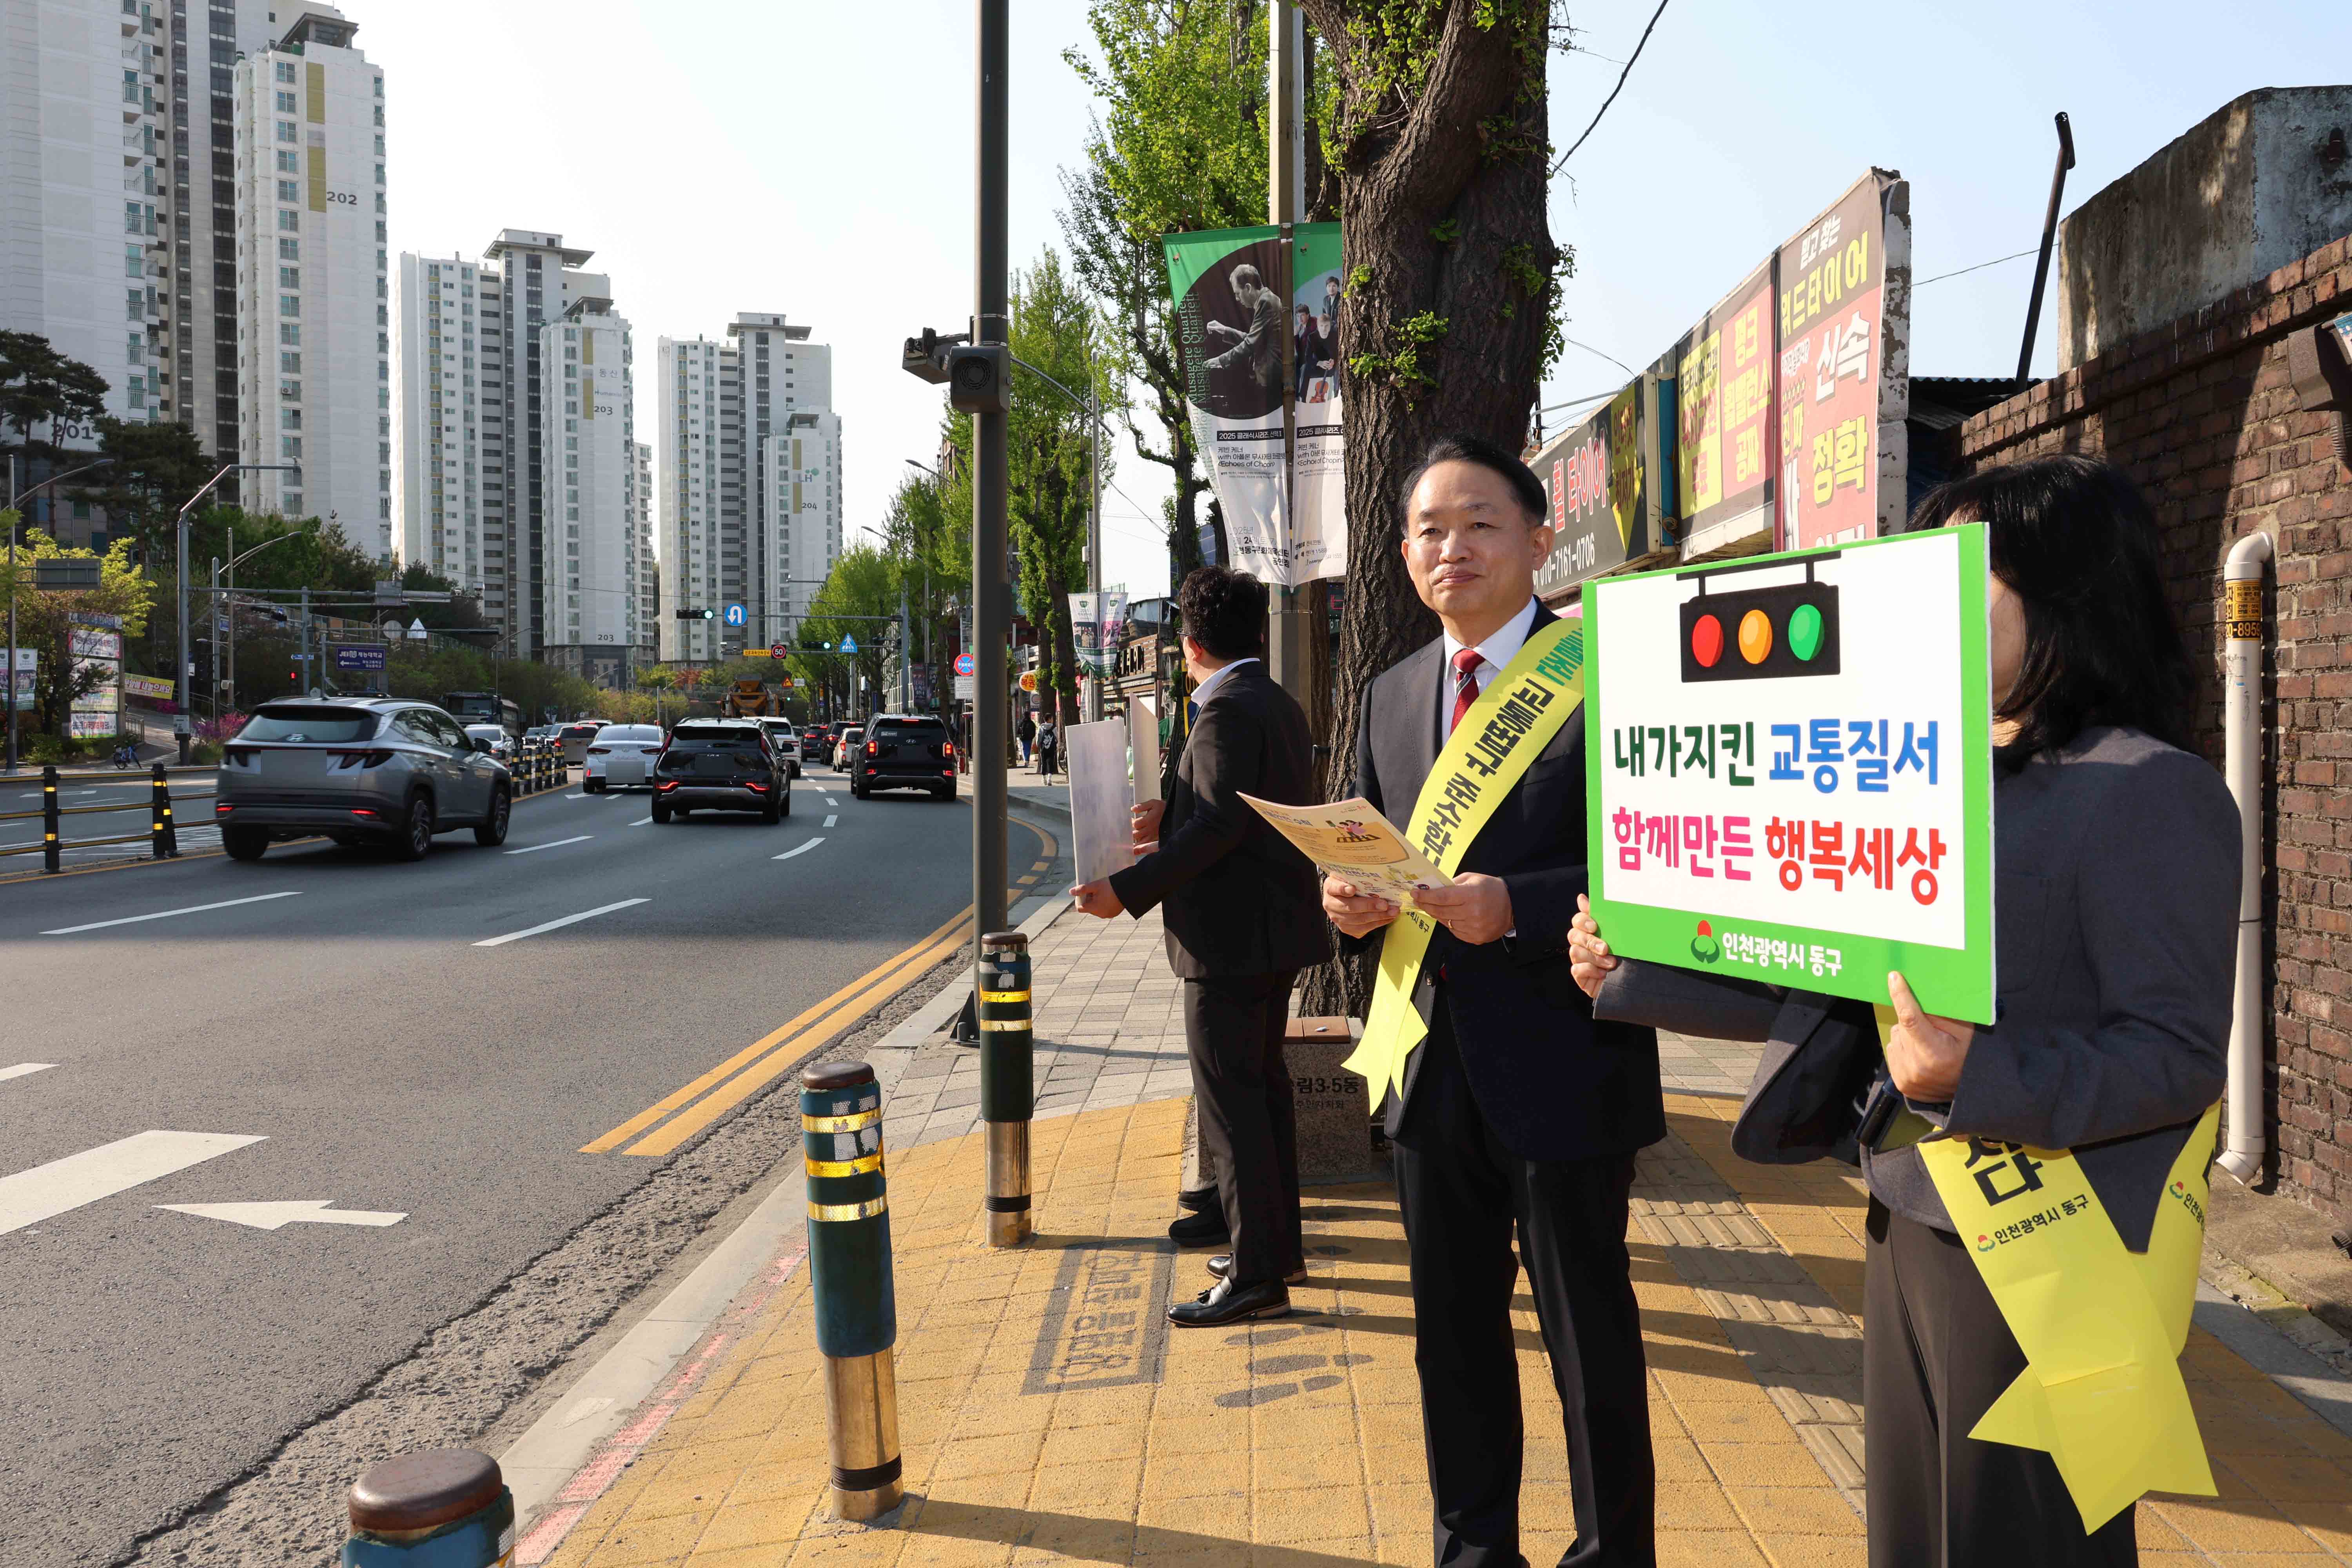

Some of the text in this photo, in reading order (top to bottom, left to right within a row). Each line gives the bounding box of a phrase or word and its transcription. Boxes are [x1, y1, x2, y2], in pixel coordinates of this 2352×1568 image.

[327, 191, 357, 205] 202
[1735, 307, 1758, 368] 펑크
[1816, 310, 1870, 402] 신속
[1184, 348, 1198, 405] Musagète
[51, 425, 94, 439] 201
[594, 406, 613, 415] 203
[1813, 414, 1868, 504] 정확
[1465, 678, 1555, 777] 교통법규
[1614, 719, 1938, 793] 내가지킨 교통질서
[1612, 806, 1947, 906] 함께만든 행복세상
[1722, 932, 1842, 977] 인천광역시 동구
[1994, 1194, 2089, 1245] 인천광역시 동구
